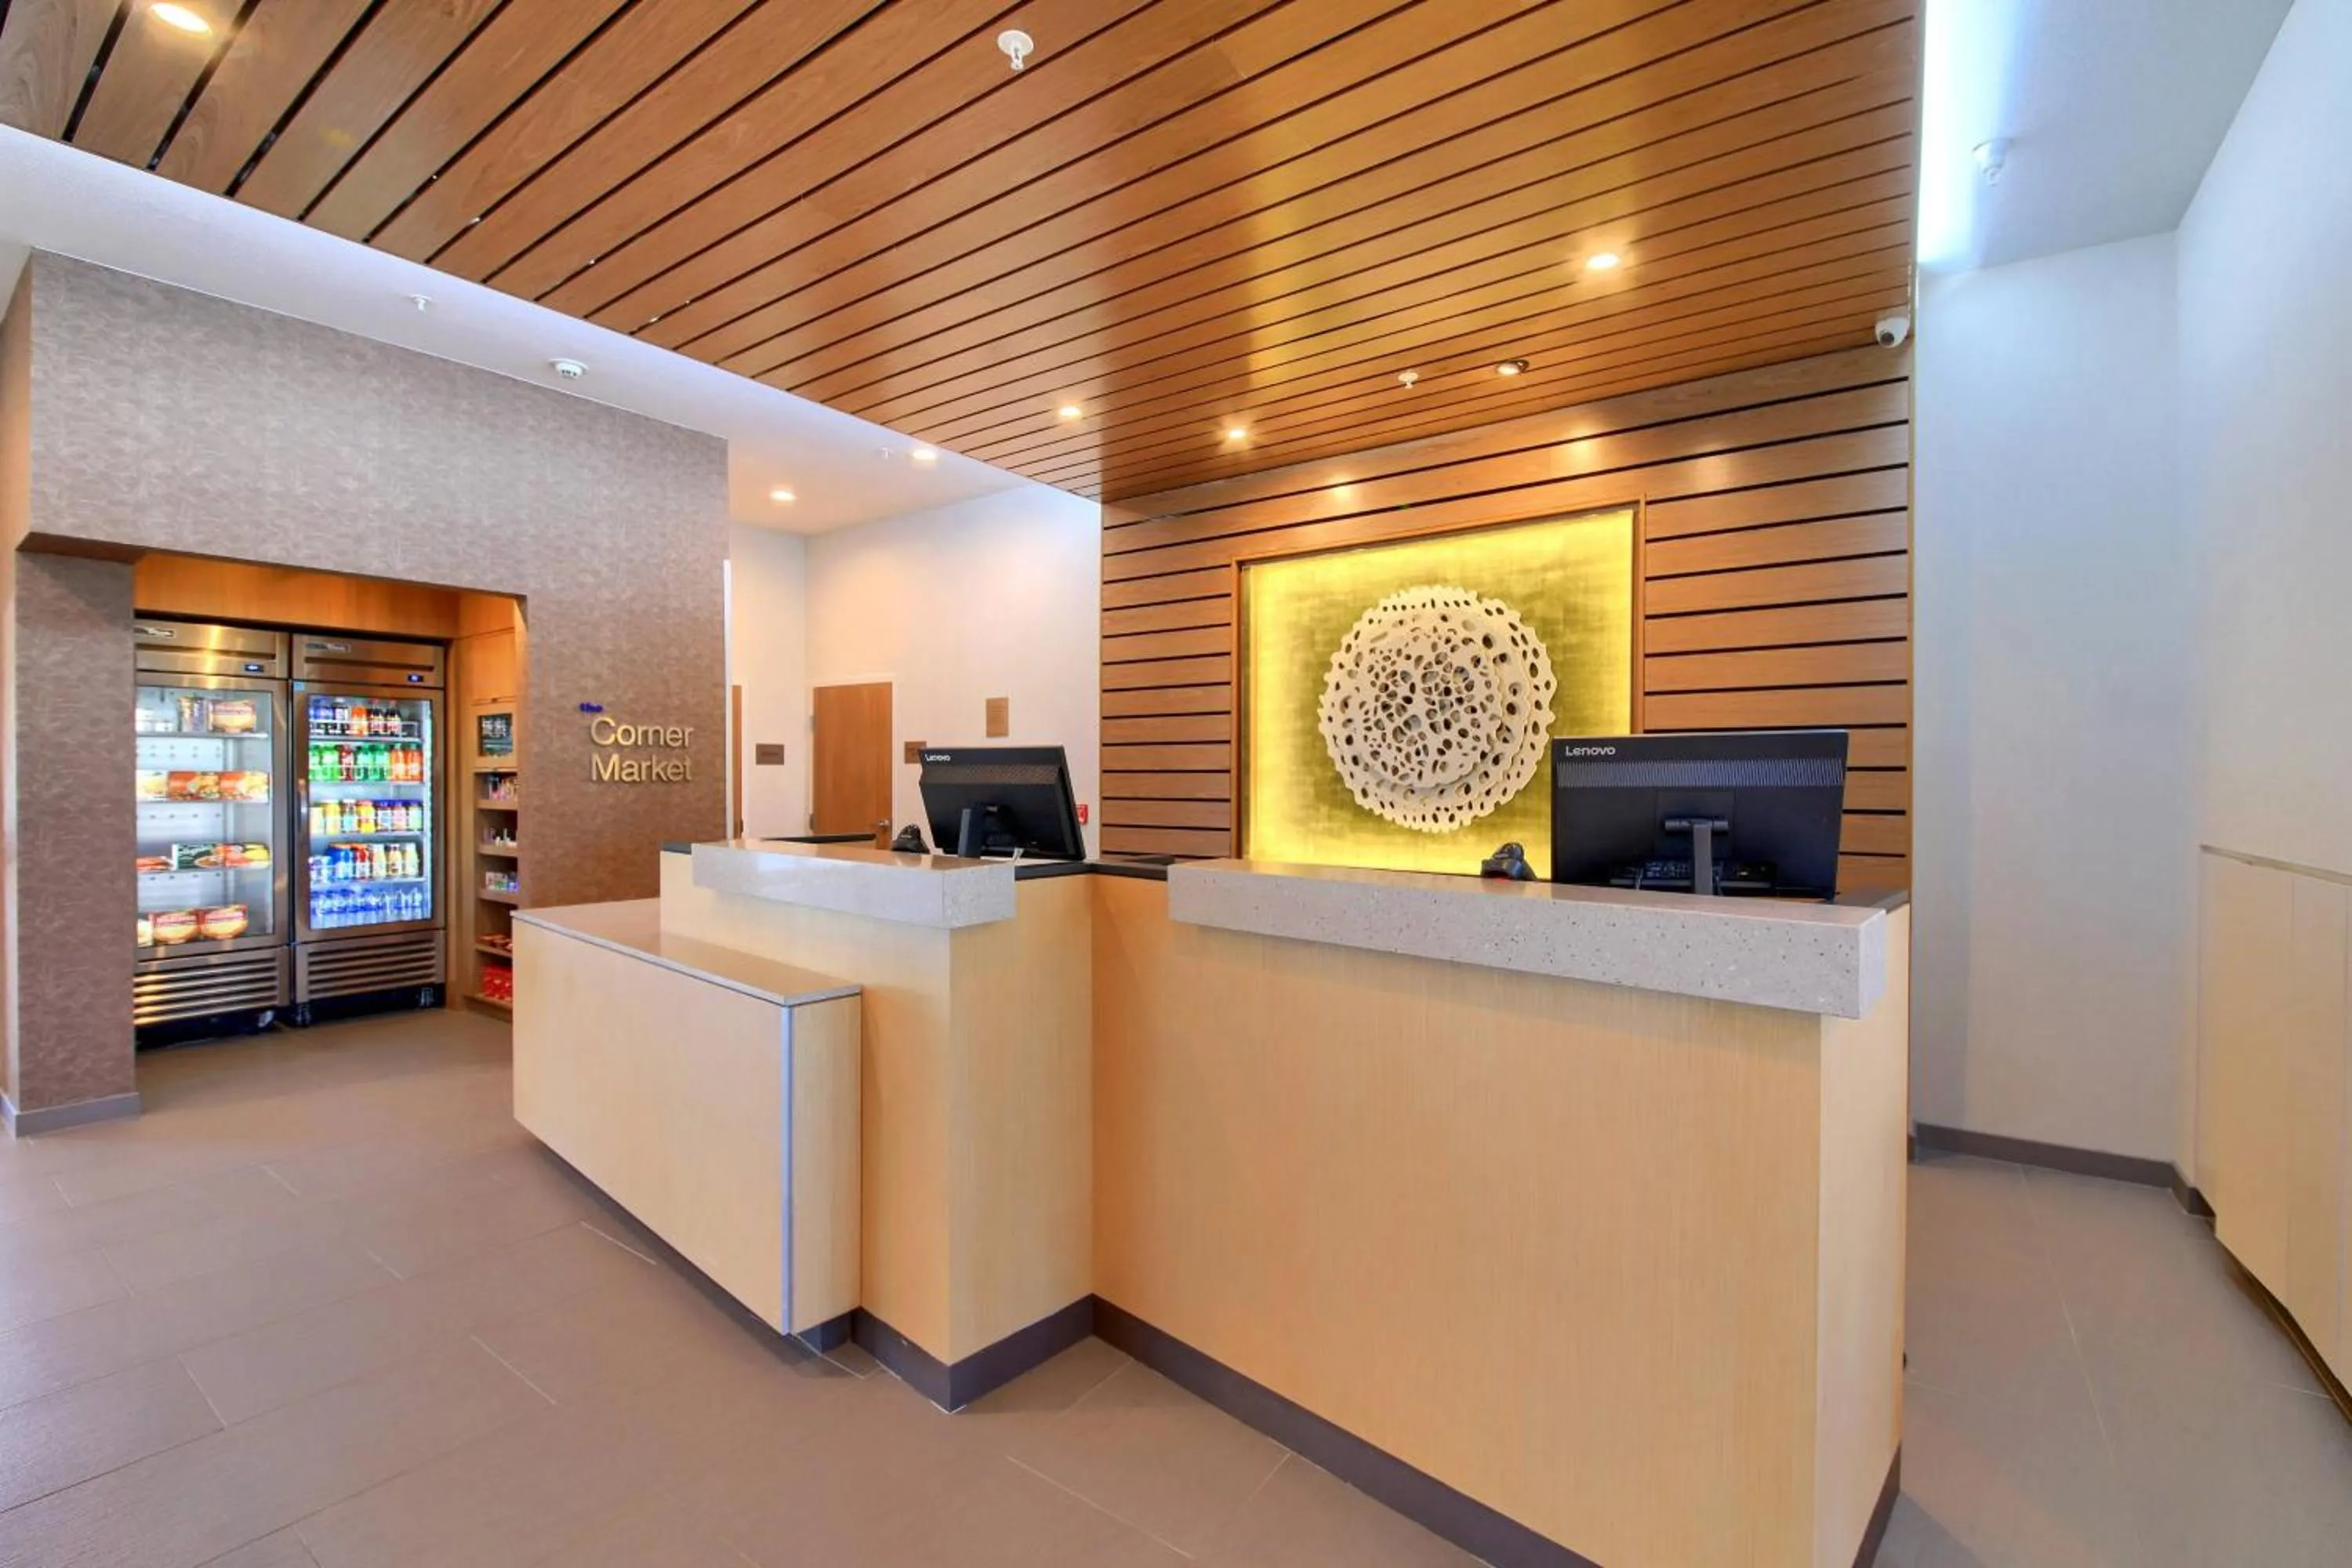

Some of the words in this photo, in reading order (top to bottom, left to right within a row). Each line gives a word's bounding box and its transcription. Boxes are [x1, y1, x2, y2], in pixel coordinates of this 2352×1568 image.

[590, 716, 695, 747] Corner
[1566, 746, 1616, 757] Lenovo
[590, 752, 693, 782] Market
